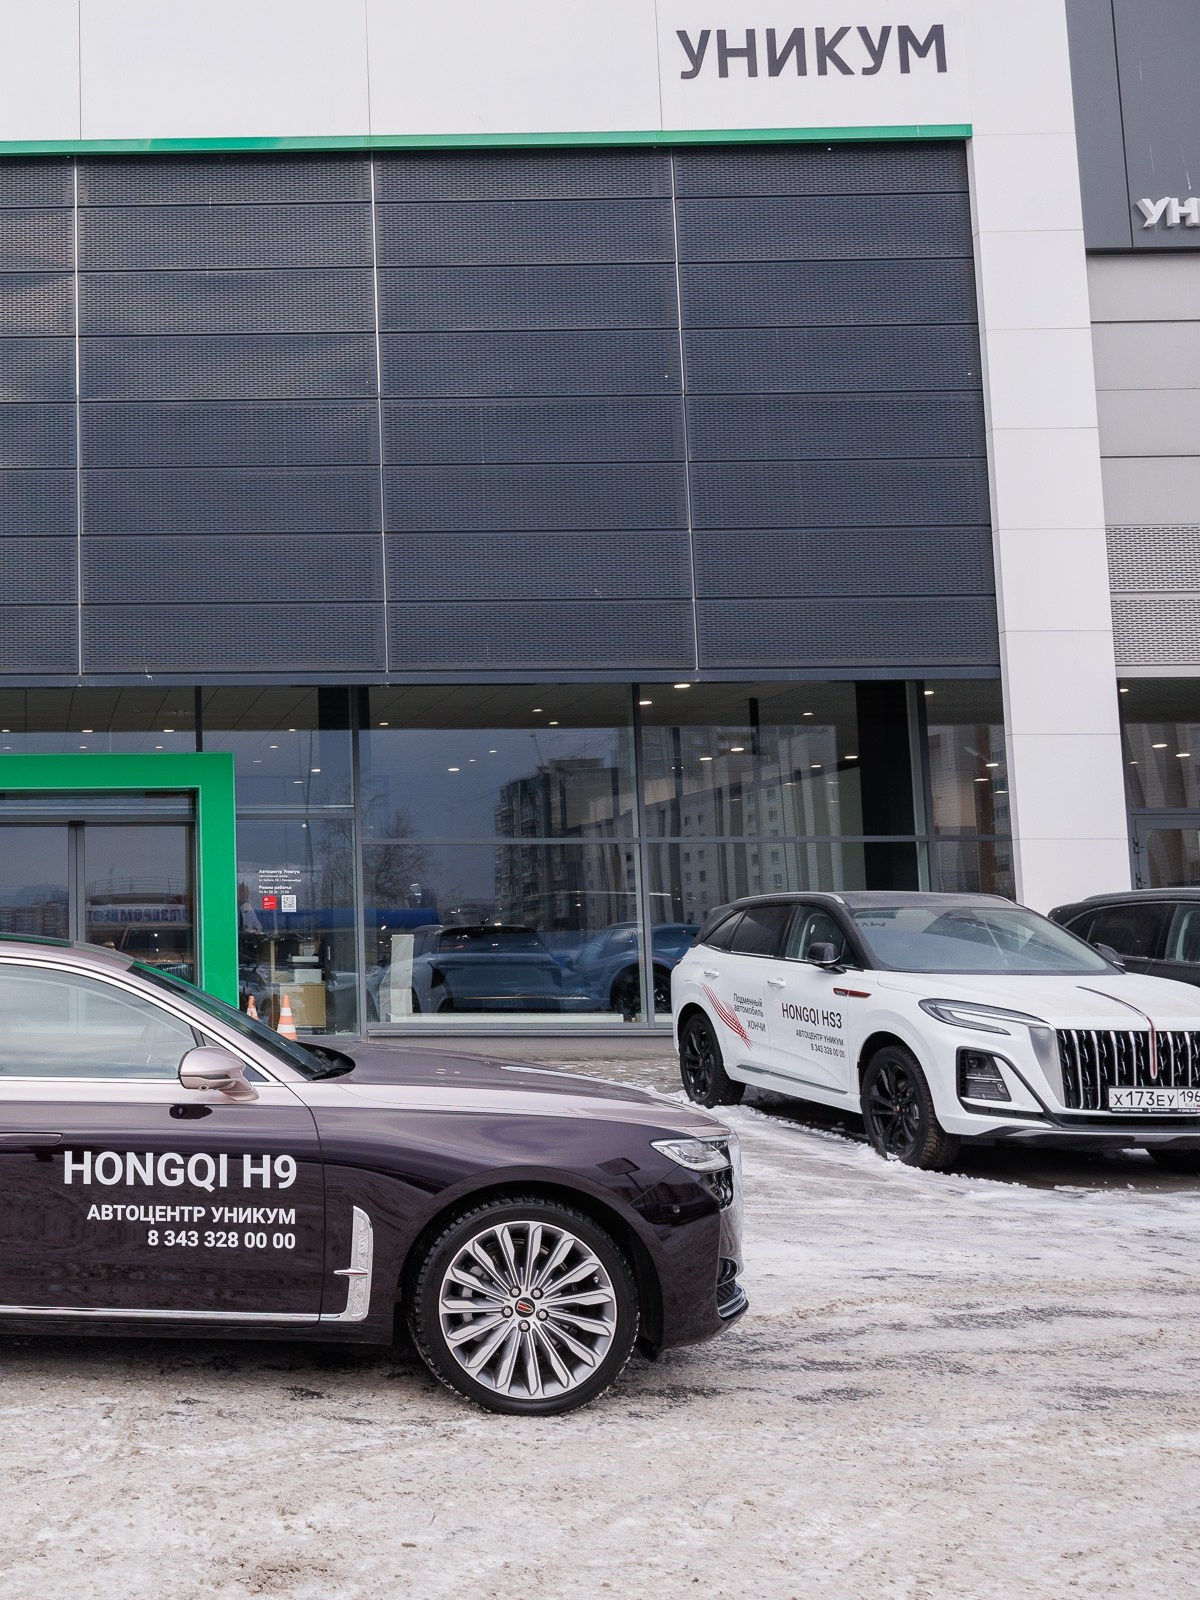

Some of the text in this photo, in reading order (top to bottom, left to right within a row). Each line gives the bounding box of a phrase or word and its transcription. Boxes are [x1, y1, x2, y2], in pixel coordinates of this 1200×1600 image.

[676, 24, 947, 79] УНИКУМ
[1136, 197, 1200, 227] УН
[734, 994, 762, 1007] Подменный
[734, 1004, 764, 1017] автомобиль
[781, 1002, 842, 1029] HONGQI HS3
[747, 1020, 766, 1032] ХОНЧИ
[796, 1030, 844, 1046] АВТОЦЕНТР УНИКУМ
[814, 1044, 823, 1053] 343
[823, 1046, 832, 1055] 328
[833, 1048, 839, 1057] 00
[839, 1049, 846, 1058] 00
[1114, 1090, 1200, 1107] Х173ЕУ 196
[63, 1150, 297, 1193] HONGQI H9
[87, 1204, 296, 1225] АВТОЦЕНТР УНИКУМ
[148, 1230, 296, 1249] 8 343 328 00 00
